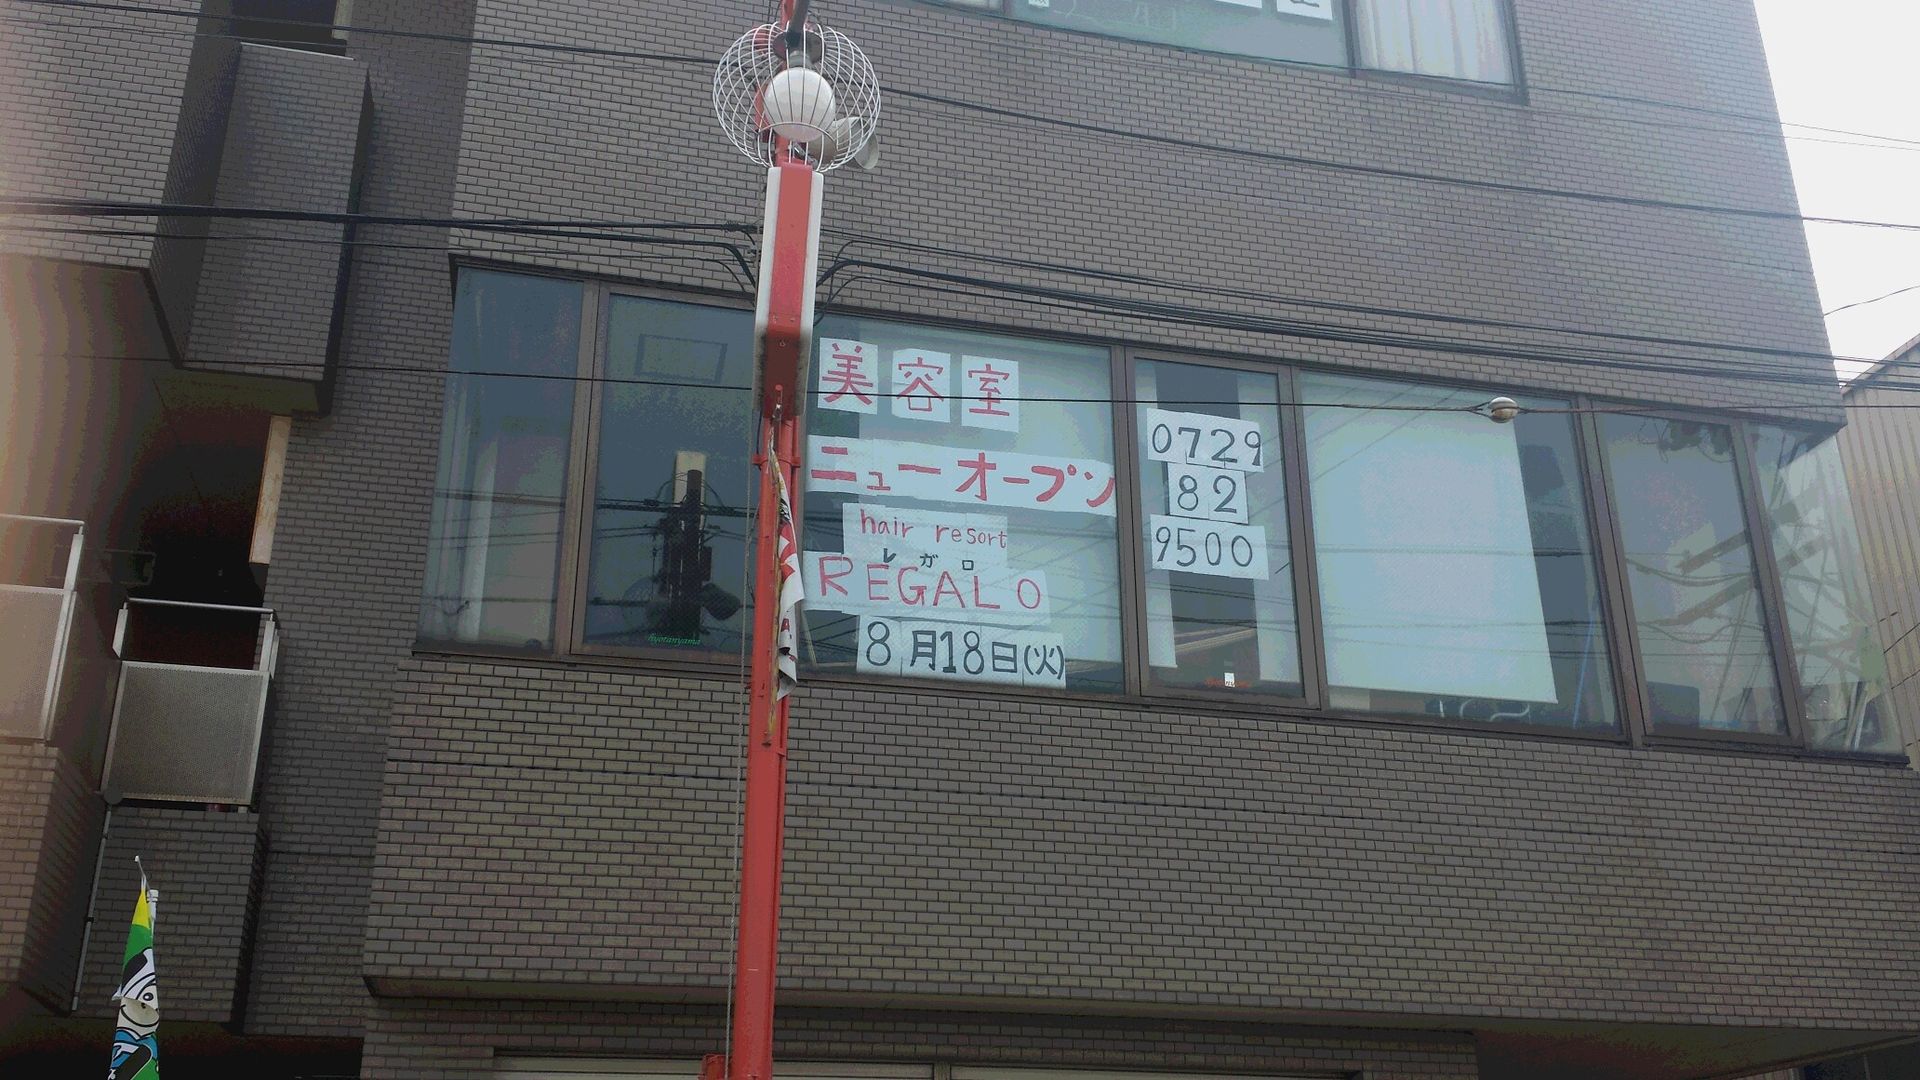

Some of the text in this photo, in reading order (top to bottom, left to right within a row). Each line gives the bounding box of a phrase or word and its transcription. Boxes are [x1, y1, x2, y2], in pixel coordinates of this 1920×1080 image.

[821, 342, 1010, 417] 美容室
[1152, 423, 1262, 467] 0729
[811, 446, 1115, 507] ニューオープン
[1177, 474, 1238, 514] 82
[860, 509, 1008, 549] hair resort
[1155, 526, 1253, 568] 9500
[818, 556, 1042, 609] REGALO
[866, 621, 1066, 680] 8月18日(火)
